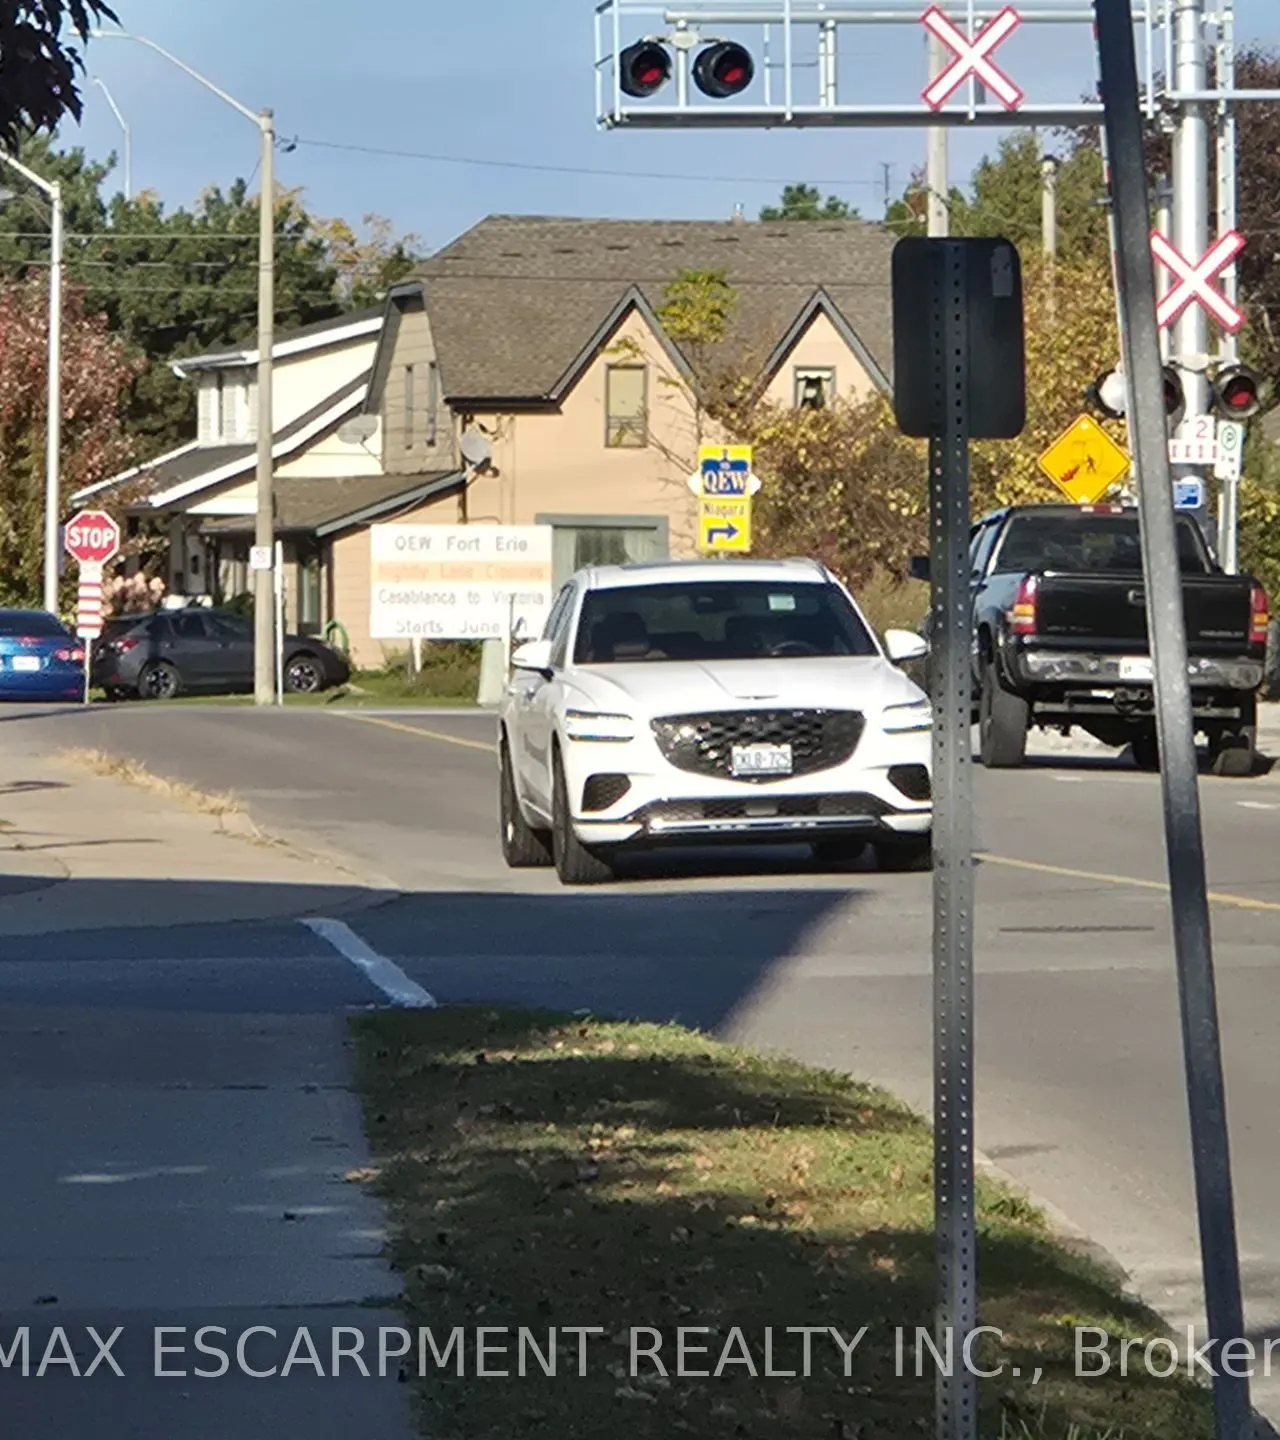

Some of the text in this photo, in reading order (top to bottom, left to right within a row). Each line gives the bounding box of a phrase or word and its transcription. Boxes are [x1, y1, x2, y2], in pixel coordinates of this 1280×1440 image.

[704, 470, 749, 493] QEW
[69, 526, 115, 549] STOP
[394, 535, 529, 553] QEW Fort Erie
[467, 590, 481, 605] to
[395, 619, 444, 634] Starts
[459, 619, 501, 635] June
